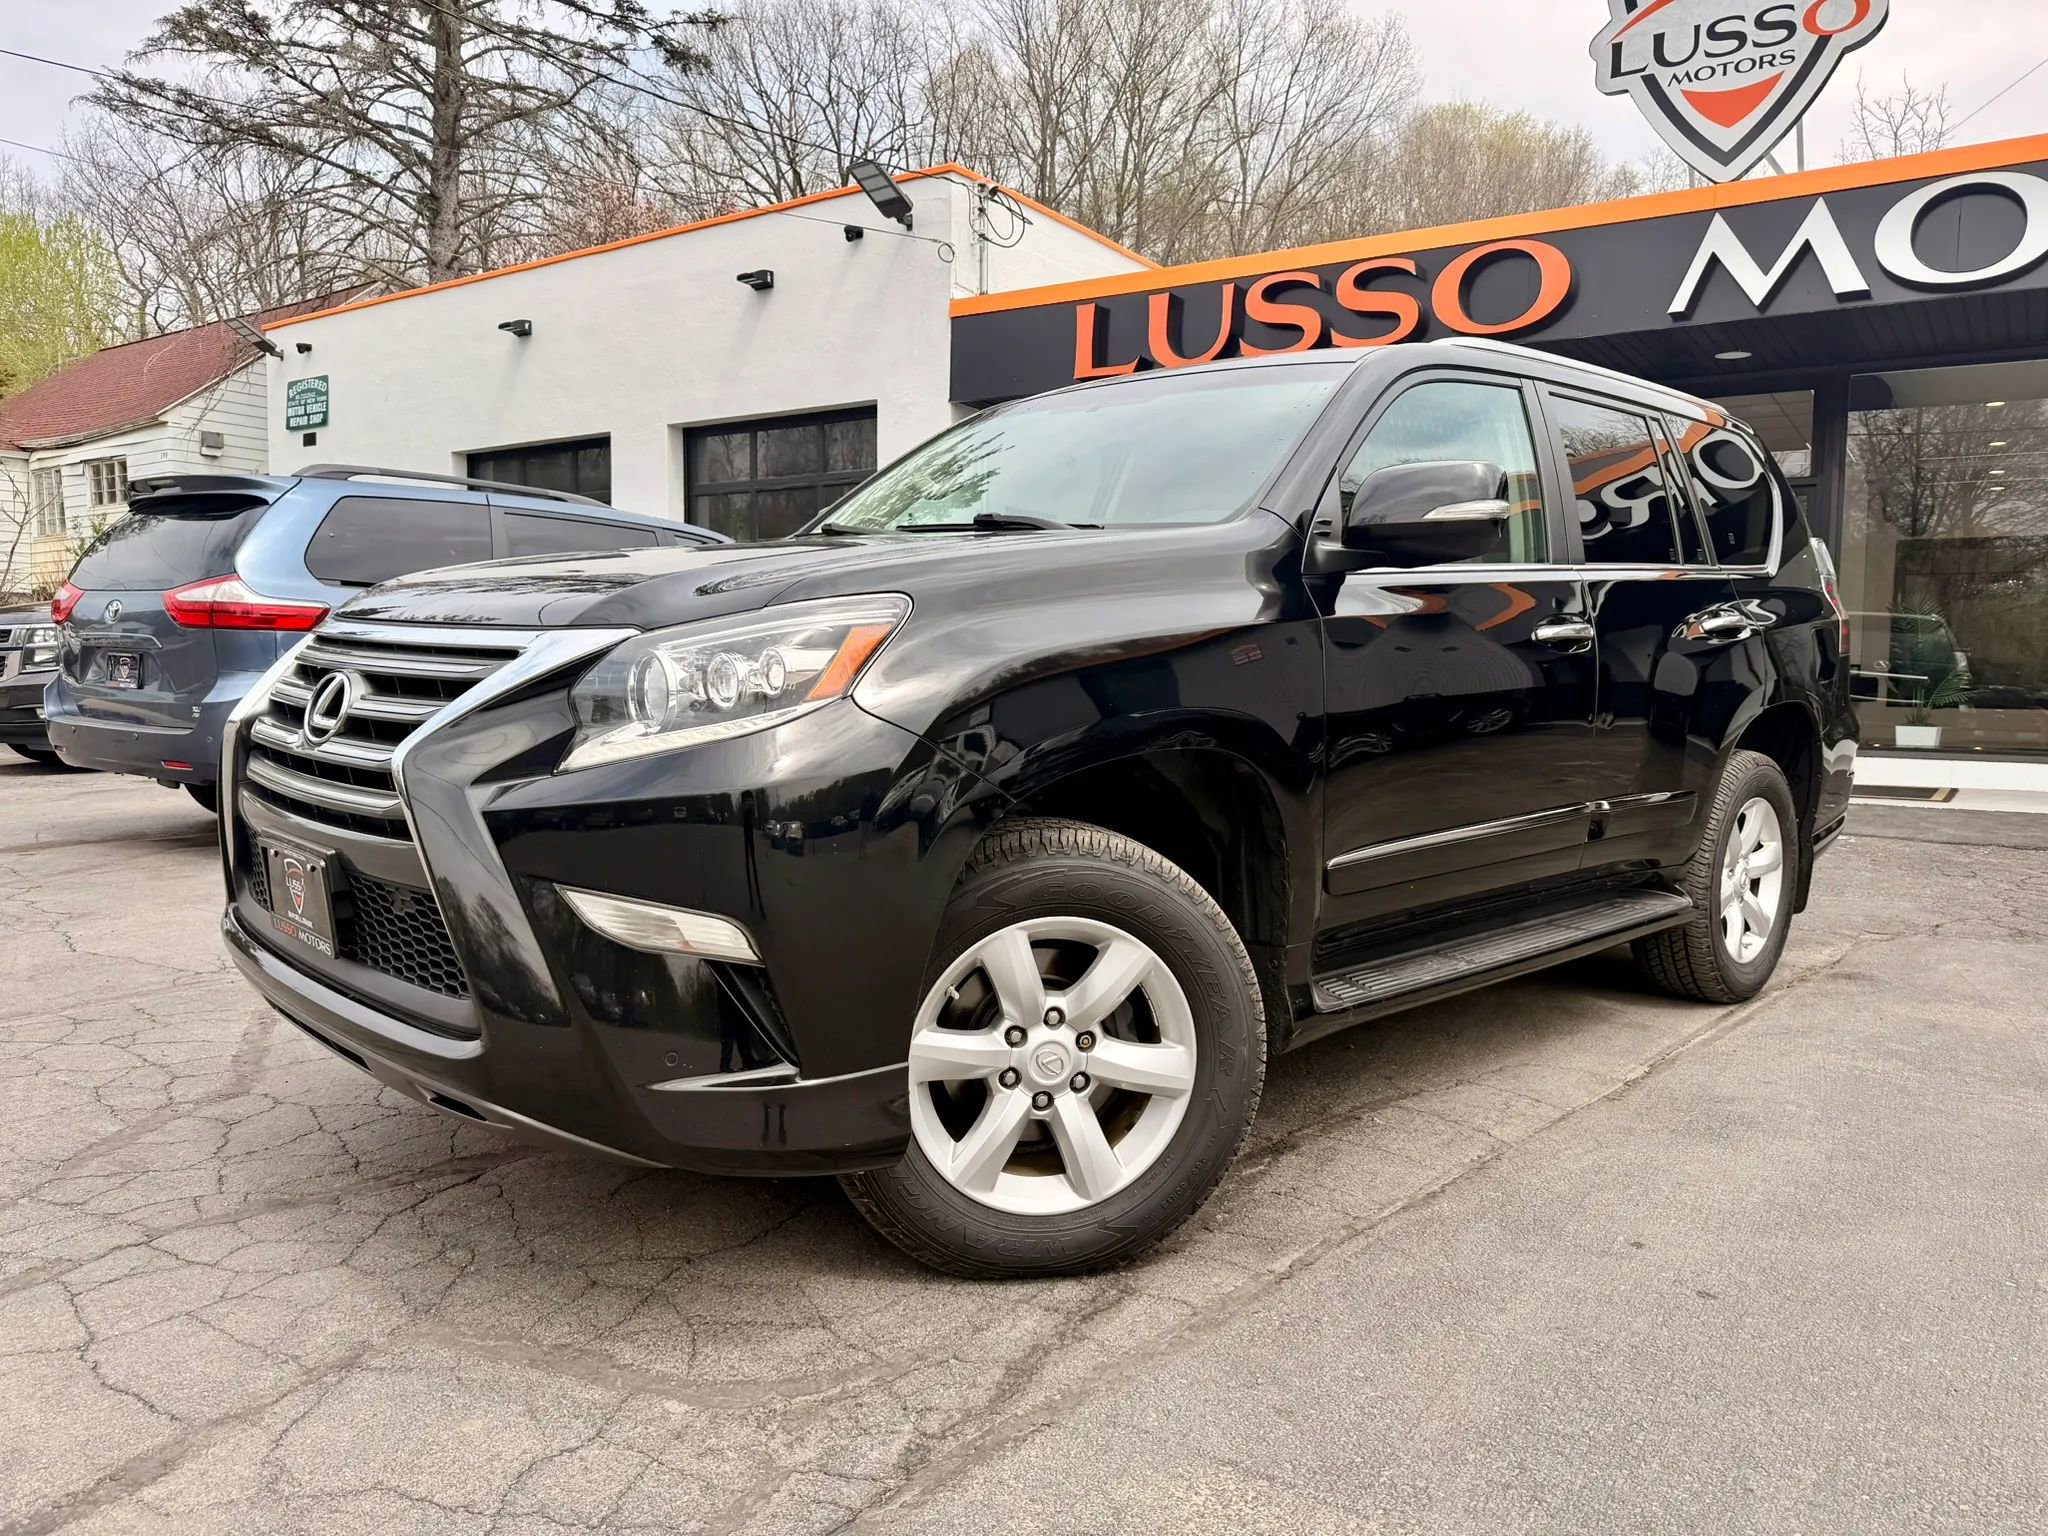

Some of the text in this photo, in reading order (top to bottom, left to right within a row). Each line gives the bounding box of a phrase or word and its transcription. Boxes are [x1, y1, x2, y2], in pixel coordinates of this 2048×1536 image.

[1610, 0, 1871, 79] LUSSO
[1667, 49, 1797, 87] MOTORS
[1073, 171, 2048, 379] LUSSO MO
[288, 378, 327, 399] REGISTERED
[288, 402, 327, 417] MOTOR VEHICLE
[290, 413, 323, 427] REPAIR SHOP
[274, 918, 297, 938] LUSSO
[298, 929, 332, 956] MOTORS
[1029, 882, 1238, 1077] GOODYEAR
